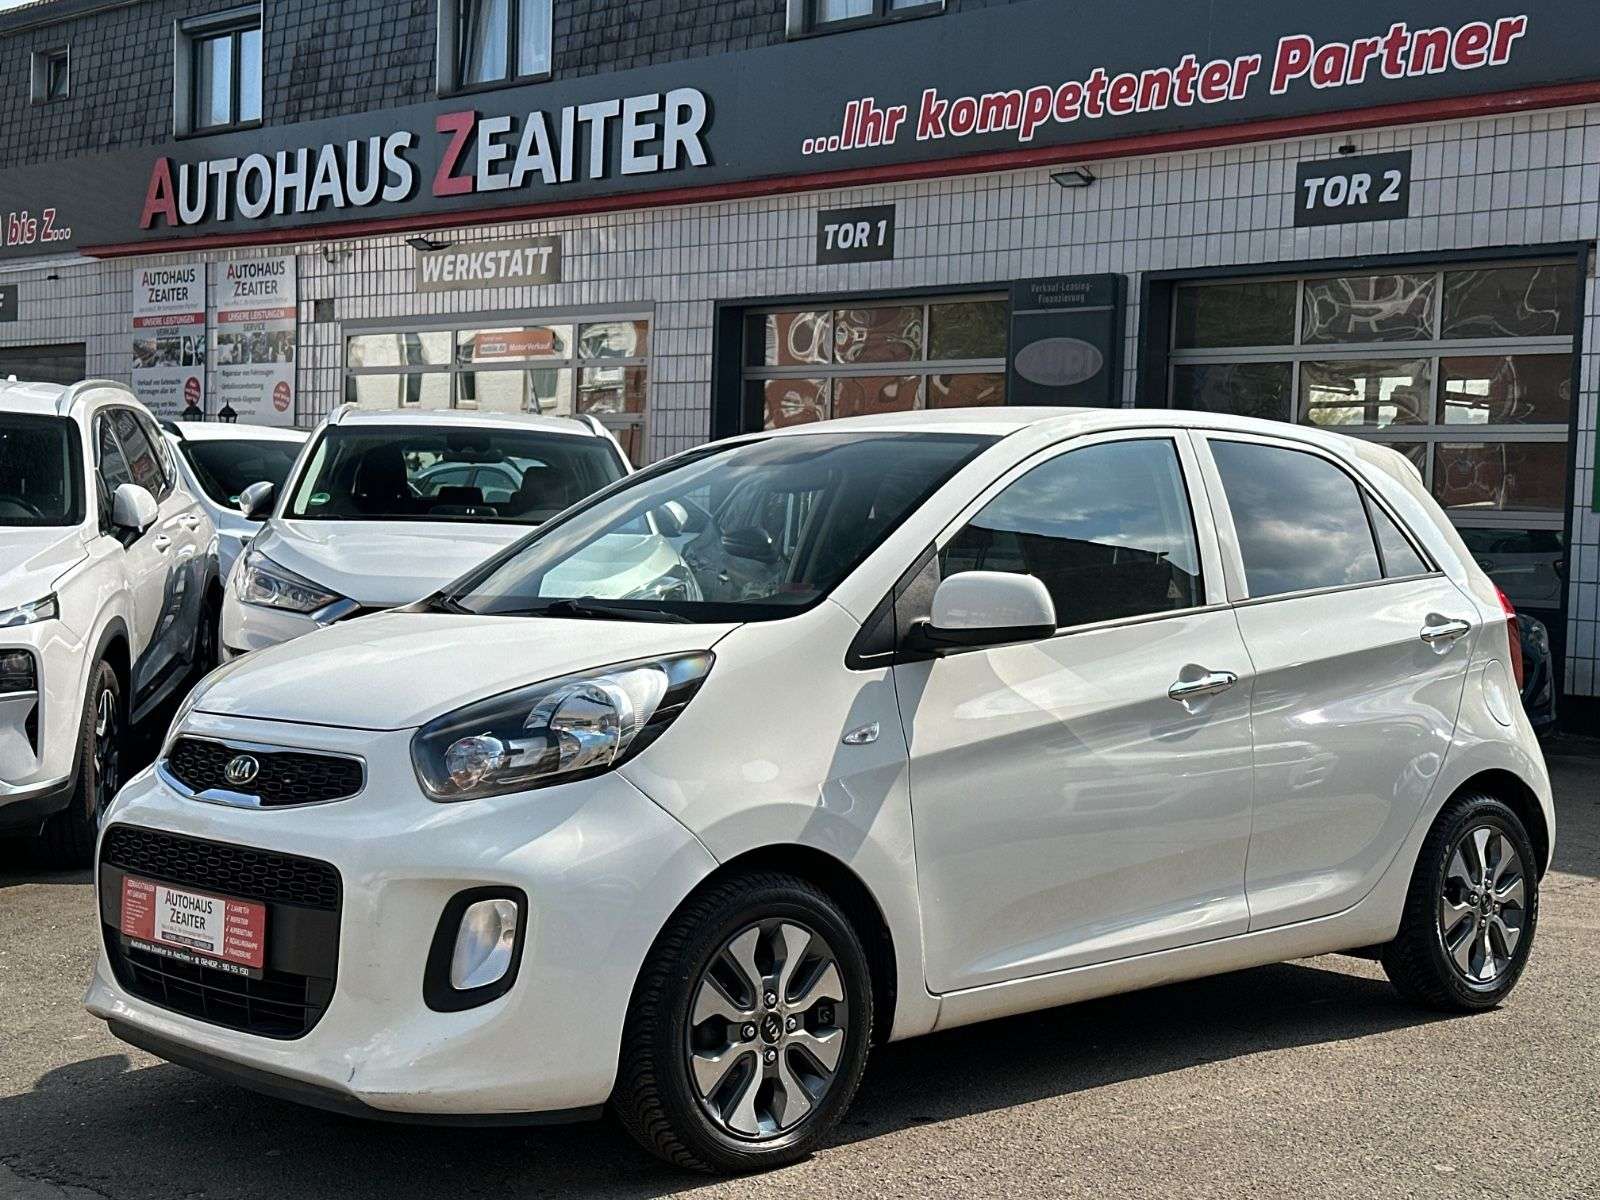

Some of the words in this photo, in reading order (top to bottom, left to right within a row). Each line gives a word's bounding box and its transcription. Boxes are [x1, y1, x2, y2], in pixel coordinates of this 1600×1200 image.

[802, 97, 907, 155] ...Ihr
[916, 53, 1261, 142] kompetenter
[1270, 15, 1527, 95] Partner
[138, 130, 414, 229] AUTOHAUS
[432, 87, 708, 197] ZEAITER
[1303, 173, 1372, 210] TOR
[1378, 170, 1402, 203] 2
[7, 210, 37, 246] bis
[41, 207, 72, 242] Z...
[824, 222, 870, 250] TOR
[877, 220, 887, 247] 1
[227, 260, 285, 279] AUTOHAUS
[422, 246, 553, 283] WERKSTATT
[142, 268, 195, 286] AUTOHAUS
[233, 280, 278, 297] ZEAITER
[148, 287, 189, 303] ZEAITER
[228, 312, 249, 322] UNSERE
[250, 310, 285, 320] LEISTUNGEN
[165, 890, 212, 914] AUTOHAUS
[170, 908, 206, 930] ZEAITER
